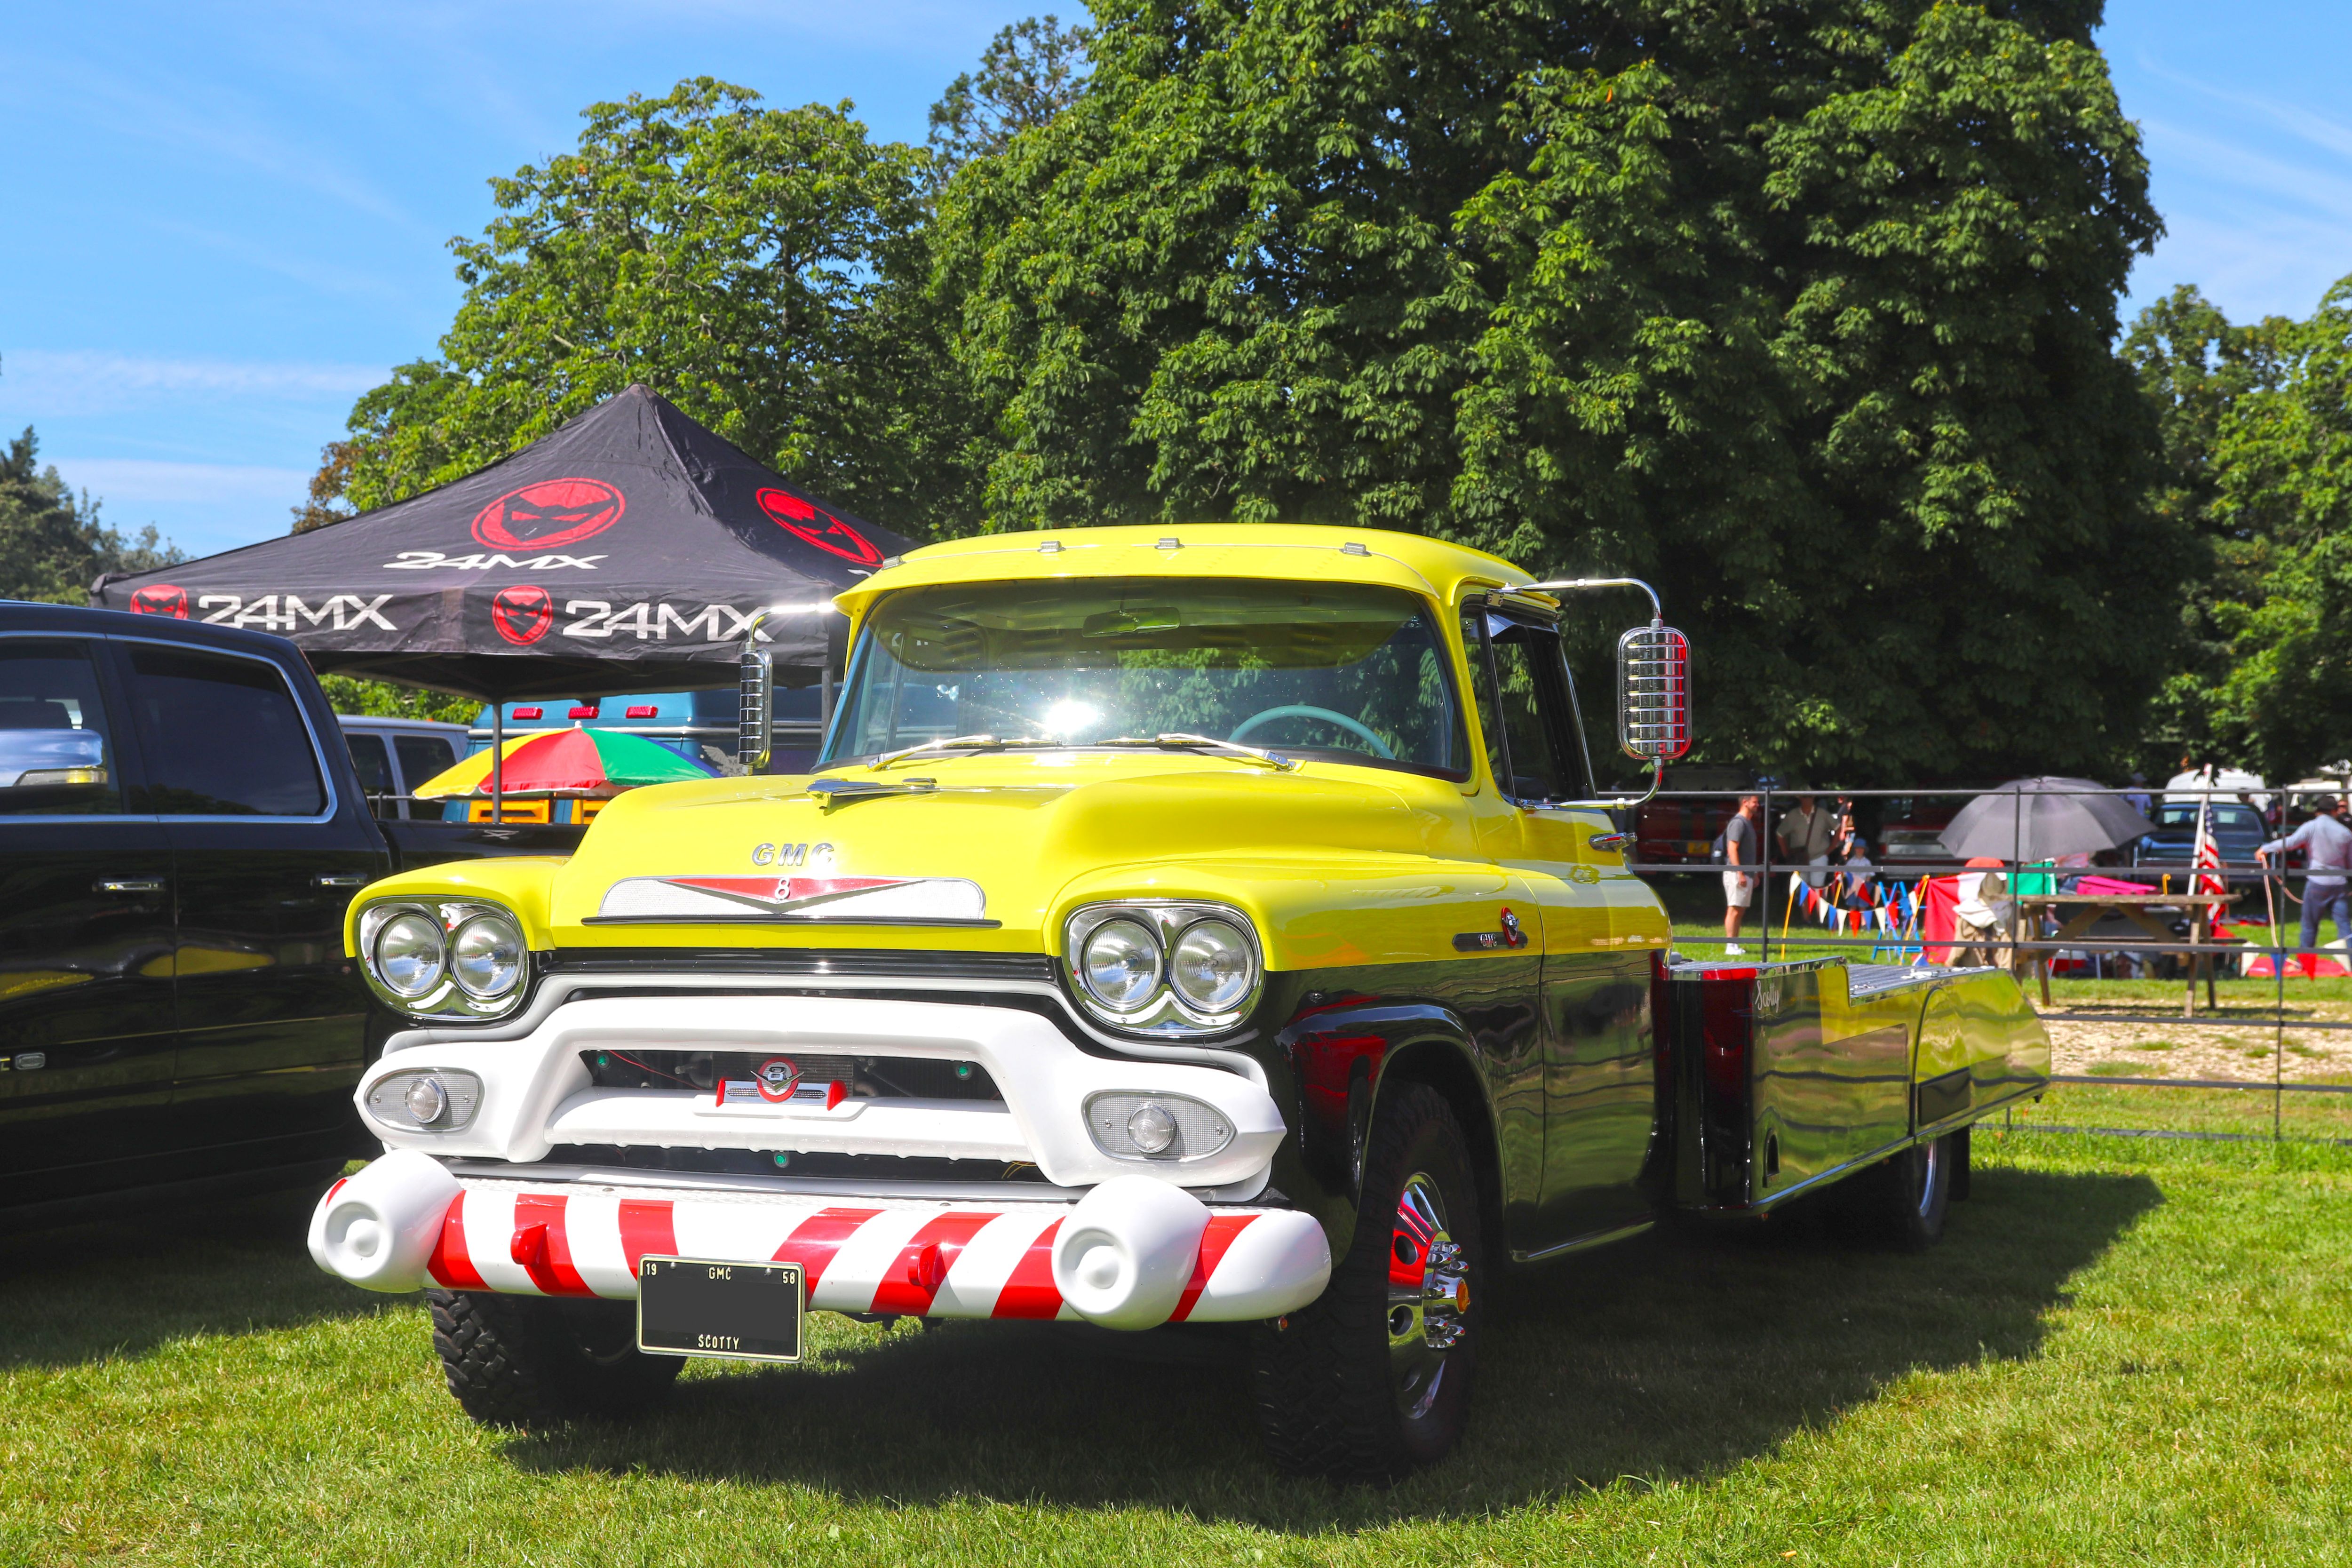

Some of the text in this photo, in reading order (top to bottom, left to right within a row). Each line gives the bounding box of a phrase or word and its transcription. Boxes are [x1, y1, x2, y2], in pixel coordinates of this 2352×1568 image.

[382, 551, 609, 570] 24MX
[198, 594, 398, 631] 24MX
[562, 600, 775, 642] 24MX
[774, 877, 790, 900] 8
[1754, 980, 1780, 1013] Scotty
[645, 1263, 796, 1284] 19 GMC 58
[698, 1334, 740, 1350] SCOTTY
